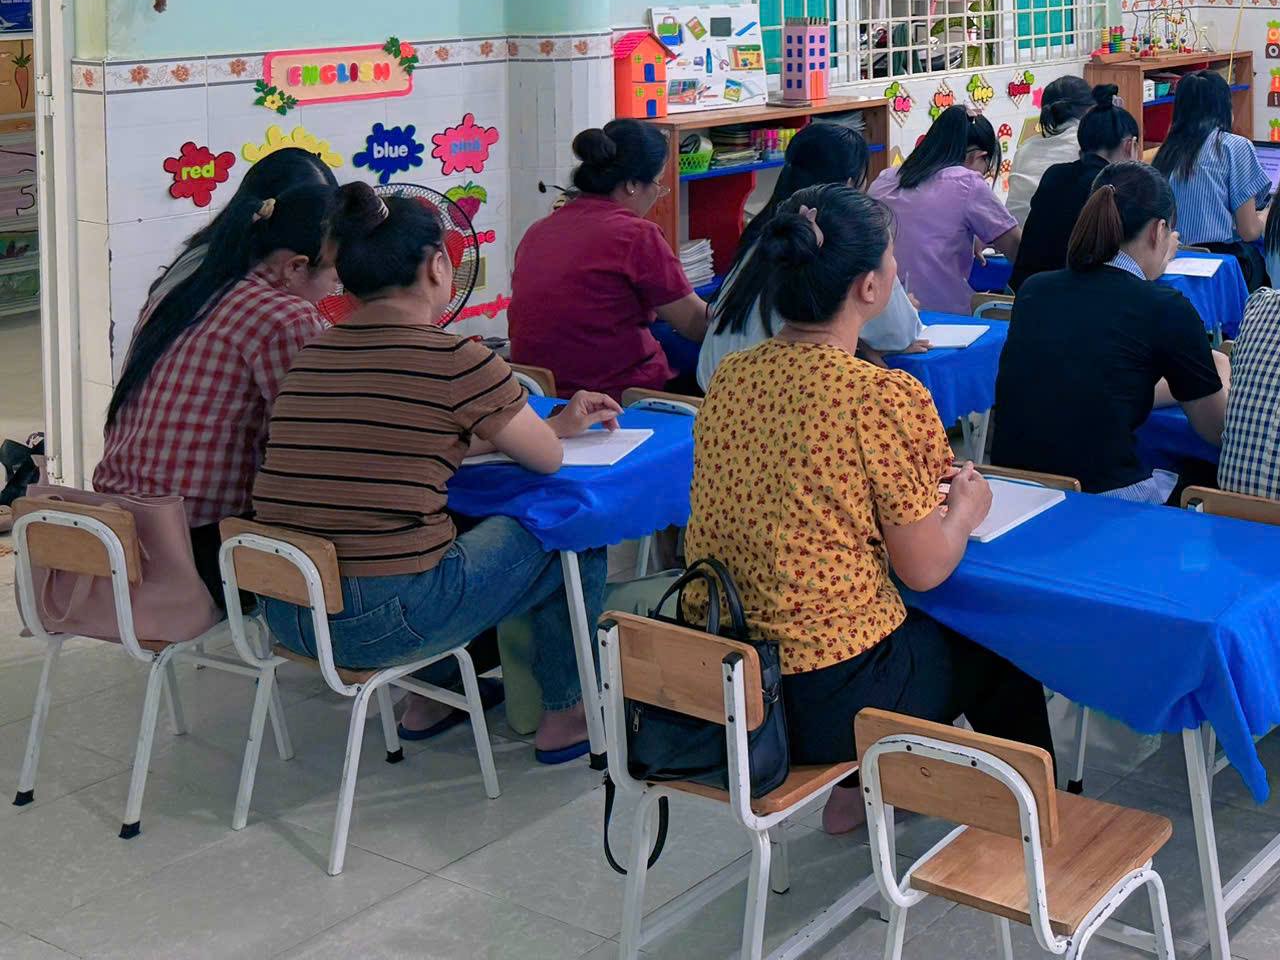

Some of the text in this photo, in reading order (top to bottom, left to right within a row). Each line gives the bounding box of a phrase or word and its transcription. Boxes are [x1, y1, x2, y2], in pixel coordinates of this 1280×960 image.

[288, 62, 392, 87] ENGLISH
[373, 142, 409, 159] blue
[181, 162, 215, 181] red
